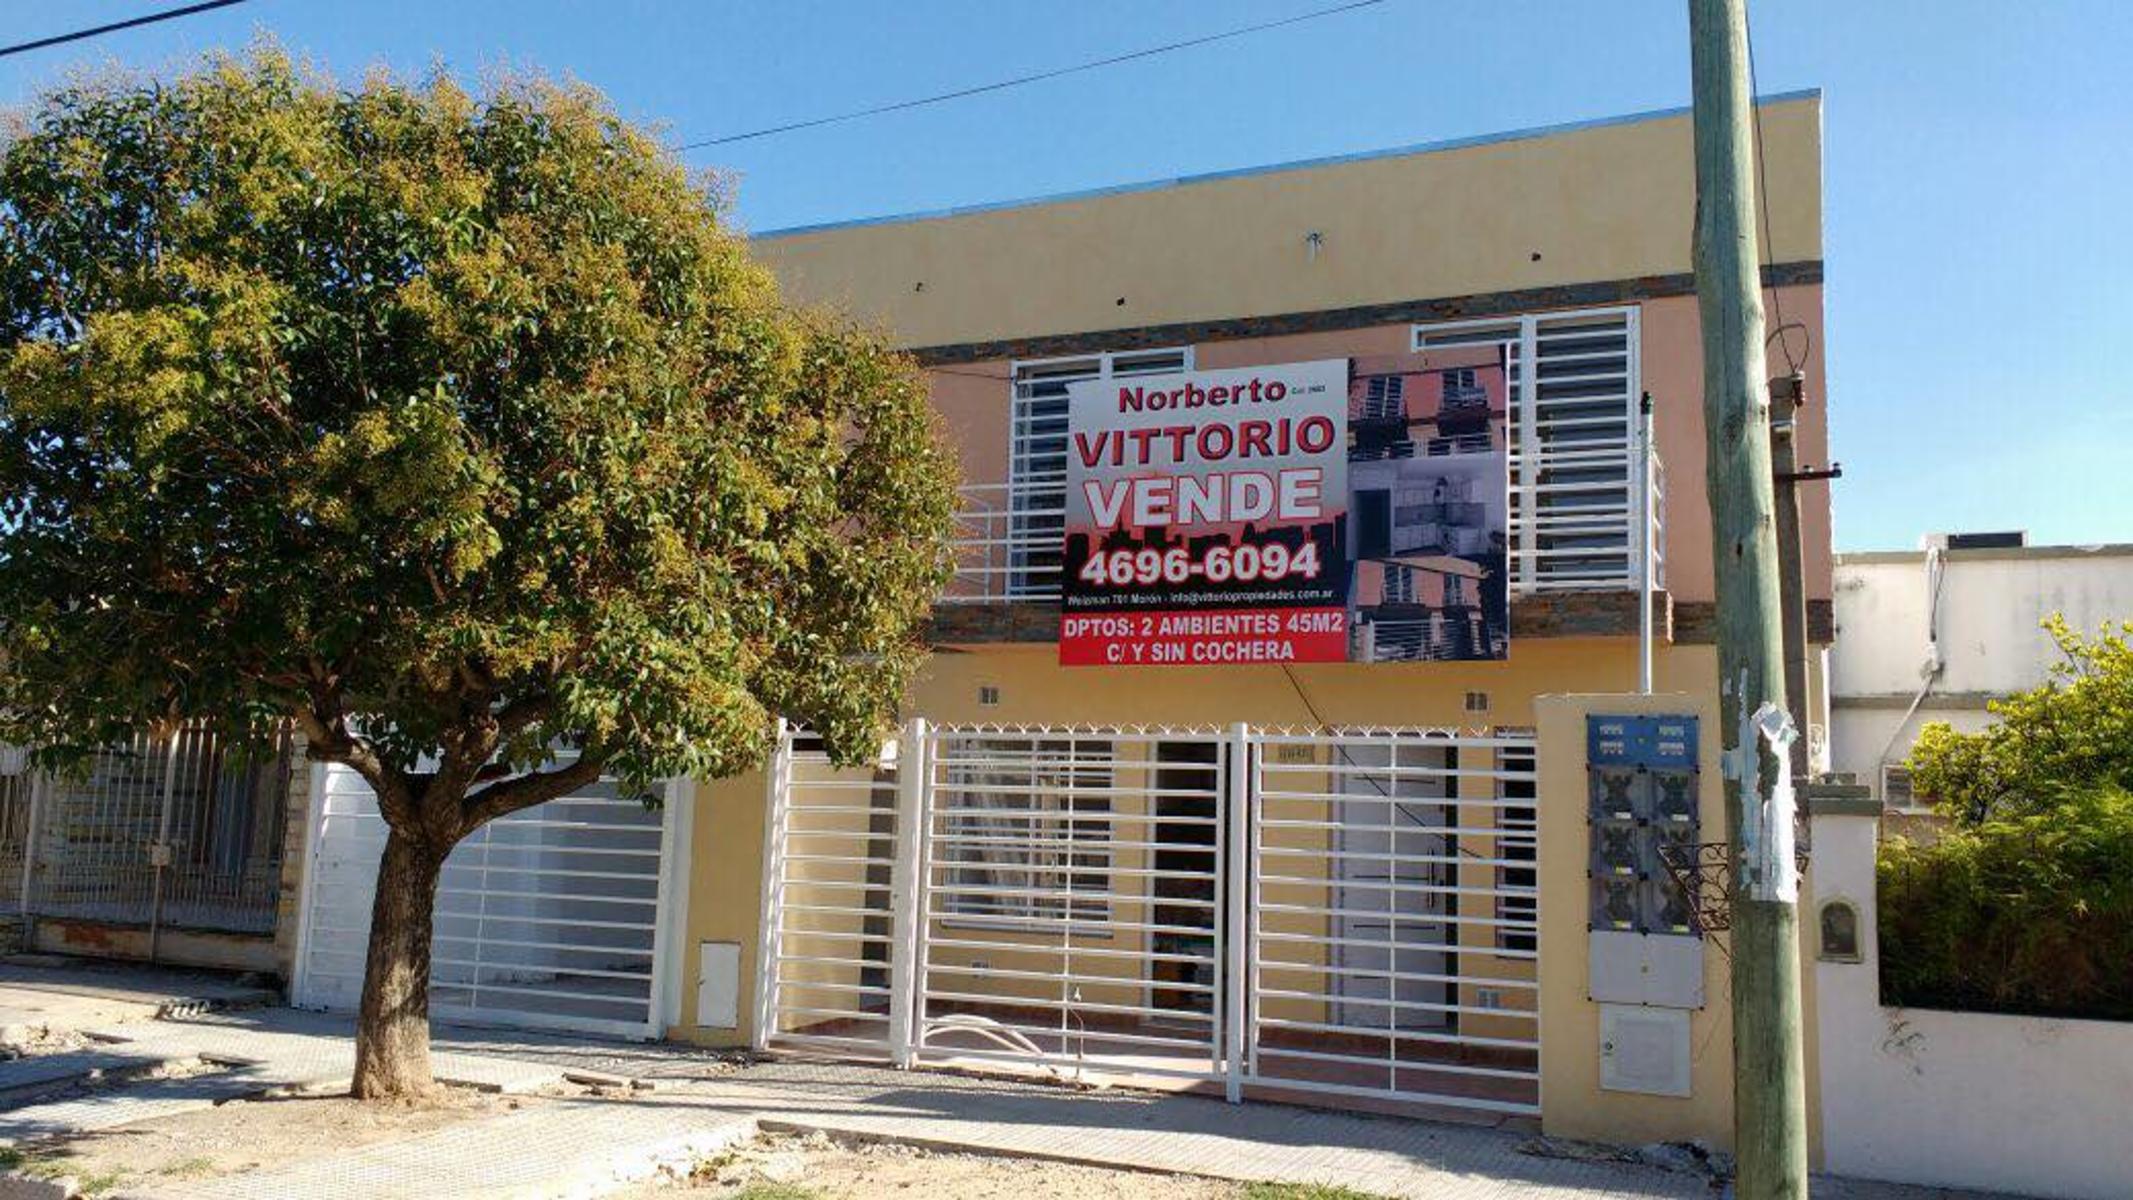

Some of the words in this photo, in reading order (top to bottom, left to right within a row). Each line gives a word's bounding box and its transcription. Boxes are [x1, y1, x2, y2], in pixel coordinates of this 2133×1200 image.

[1119, 377, 1287, 413] Norberto
[1075, 415, 1335, 468] VITTORIO
[1083, 467, 1322, 529] VENDE
[1079, 542, 1321, 586] 4696-6094
[1064, 616, 1135, 638] DPTOS:
[1142, 616, 1152, 636] 2
[1159, 613, 1281, 635] AMBIENTES
[1287, 612, 1343, 633] 45M2
[1132, 643, 1145, 661] Y
[1152, 642, 1186, 661] SIN
[1192, 640, 1295, 661] COCHERA
